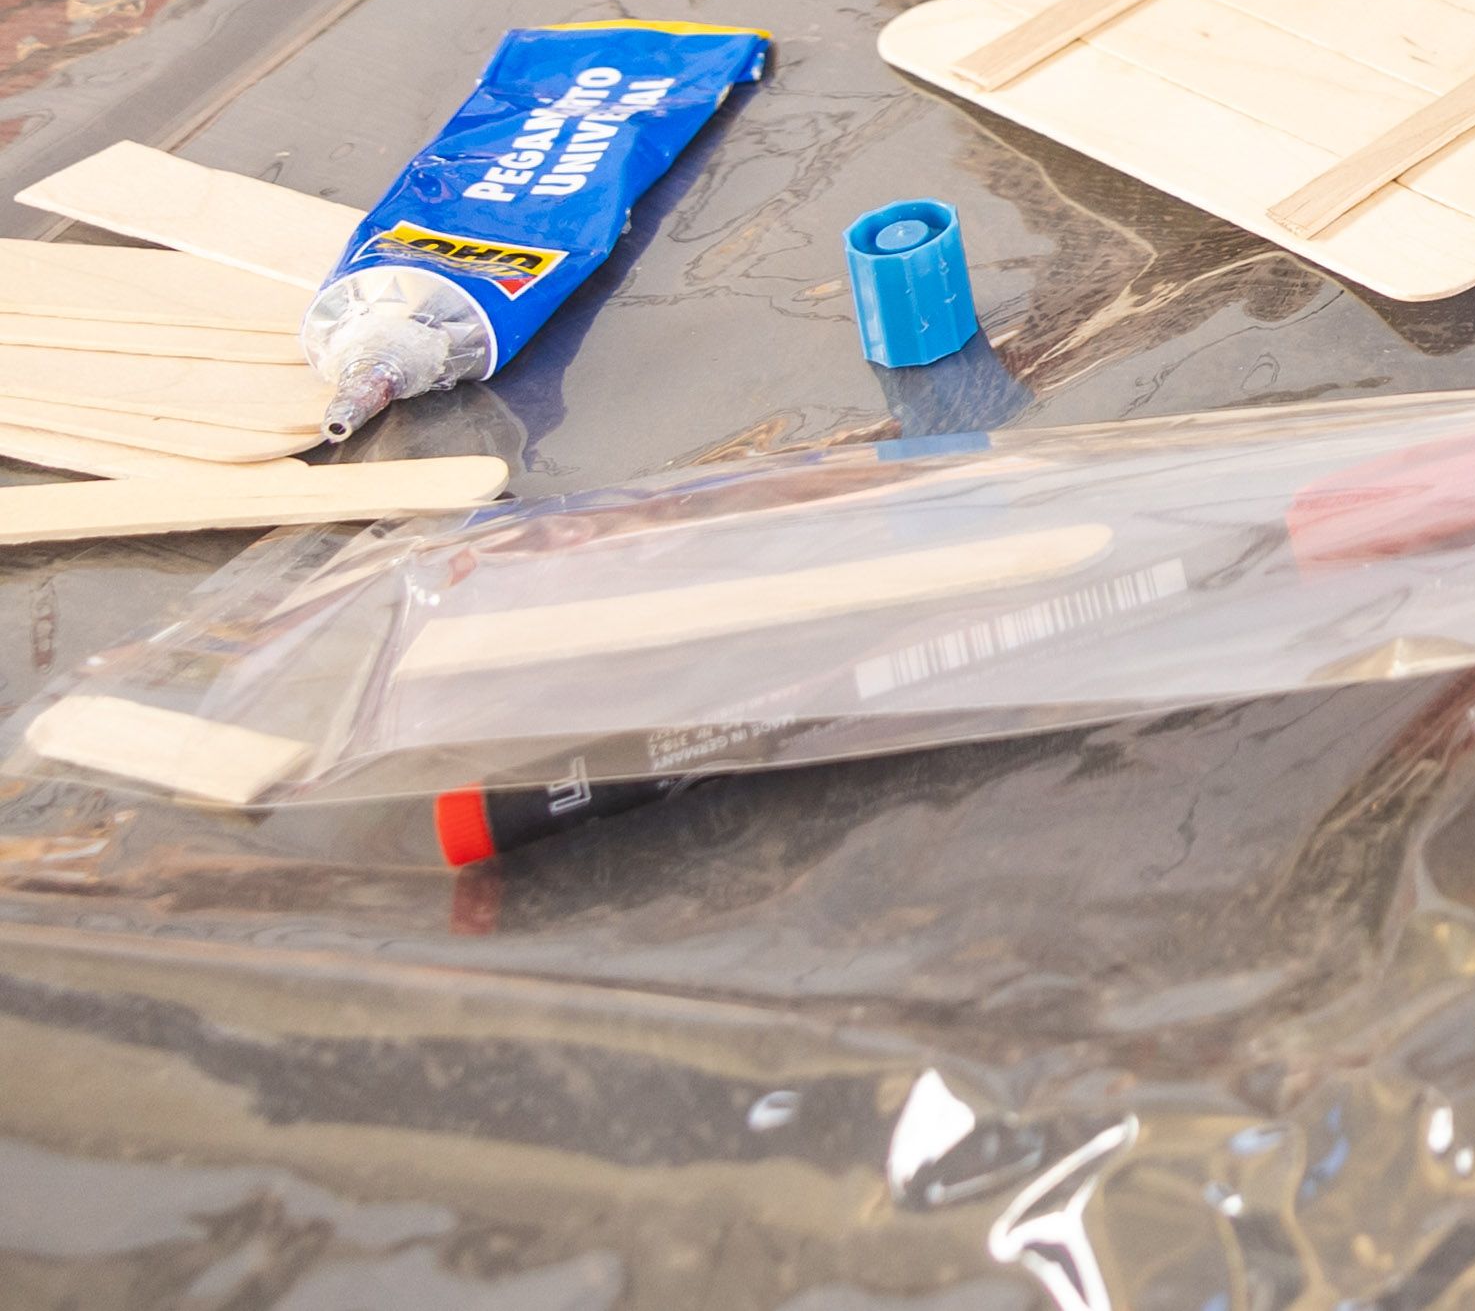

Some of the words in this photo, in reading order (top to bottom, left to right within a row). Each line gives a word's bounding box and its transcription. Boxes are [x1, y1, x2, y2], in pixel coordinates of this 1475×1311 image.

[408, 238, 543, 270] UHU
[653, 734, 729, 772] GERMANY
[729, 728, 749, 743] IN
[546, 756, 592, 816] F
